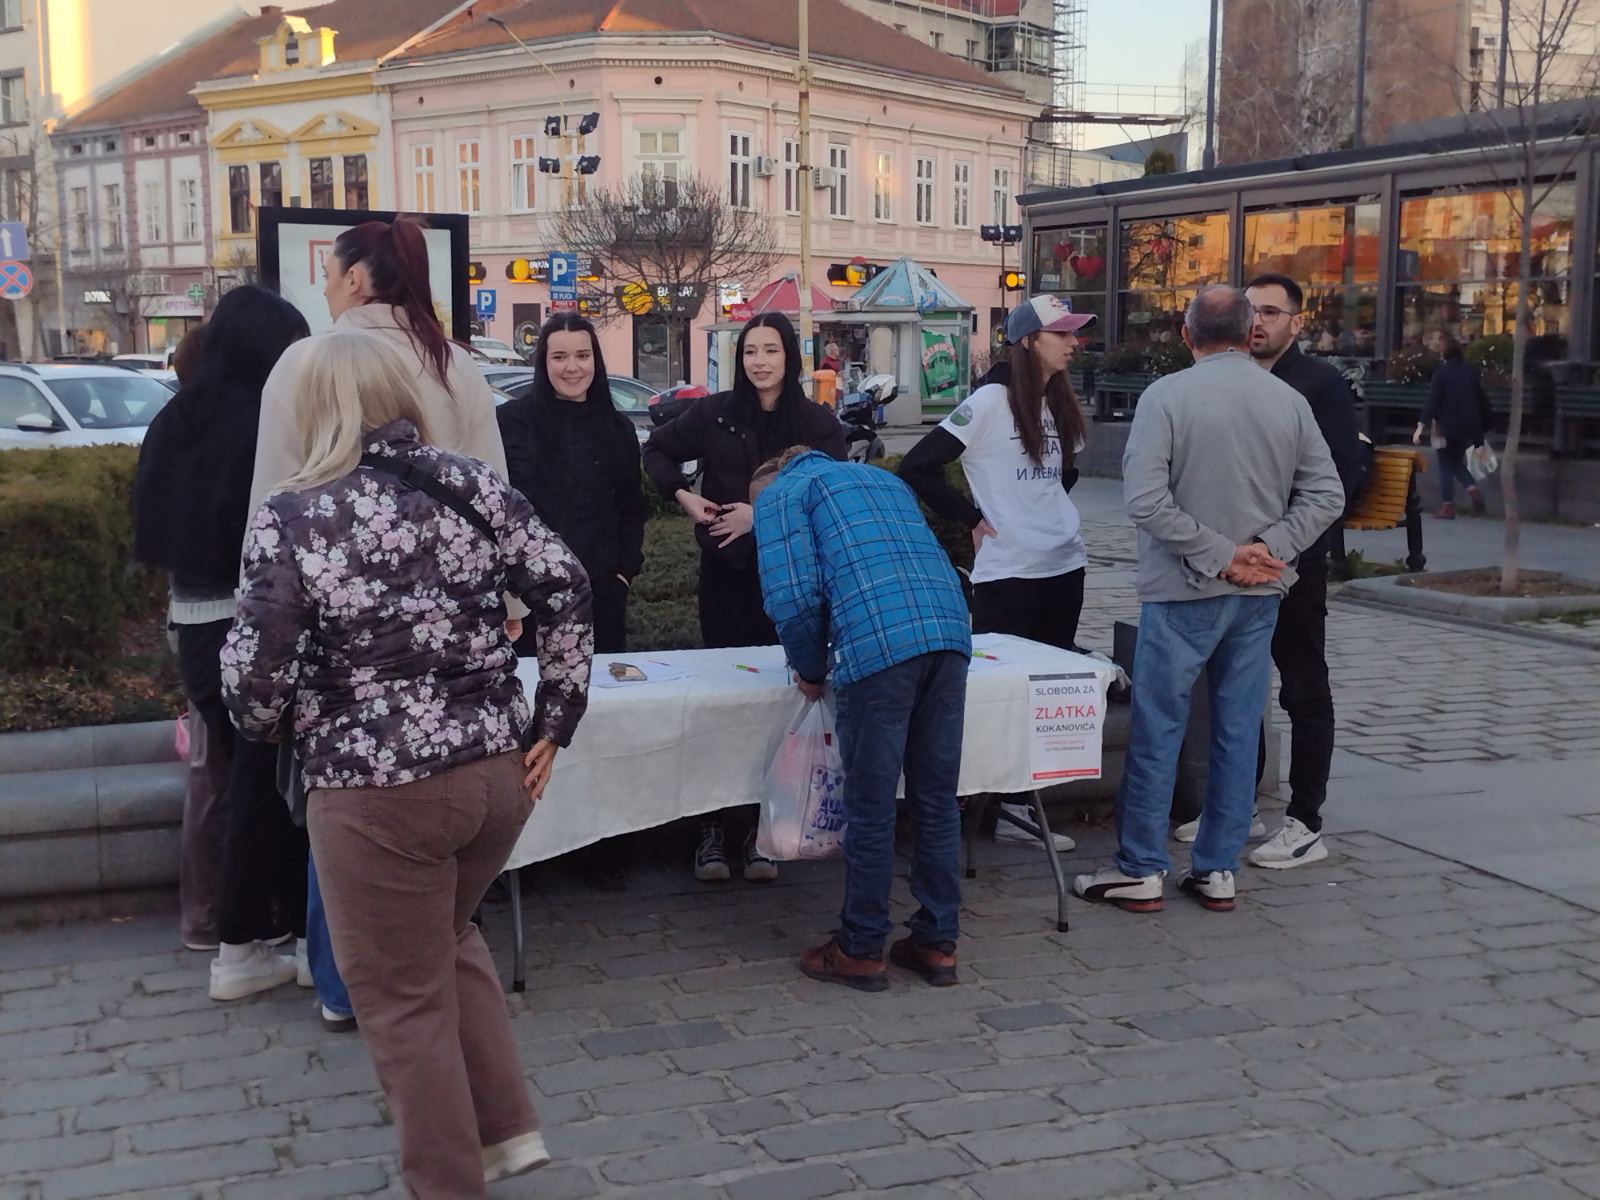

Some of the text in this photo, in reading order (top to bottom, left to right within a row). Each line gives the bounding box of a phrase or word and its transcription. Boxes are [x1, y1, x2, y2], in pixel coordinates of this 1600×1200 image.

[552, 258, 568, 281] P
[480, 291, 493, 310] P
[1017, 468, 1027, 480] И
[1035, 685, 1095, 696] SLOBODA ZA
[1035, 705, 1096, 720] ZLATKA
[1036, 721, 1095, 733] KOKANOVIĆA
